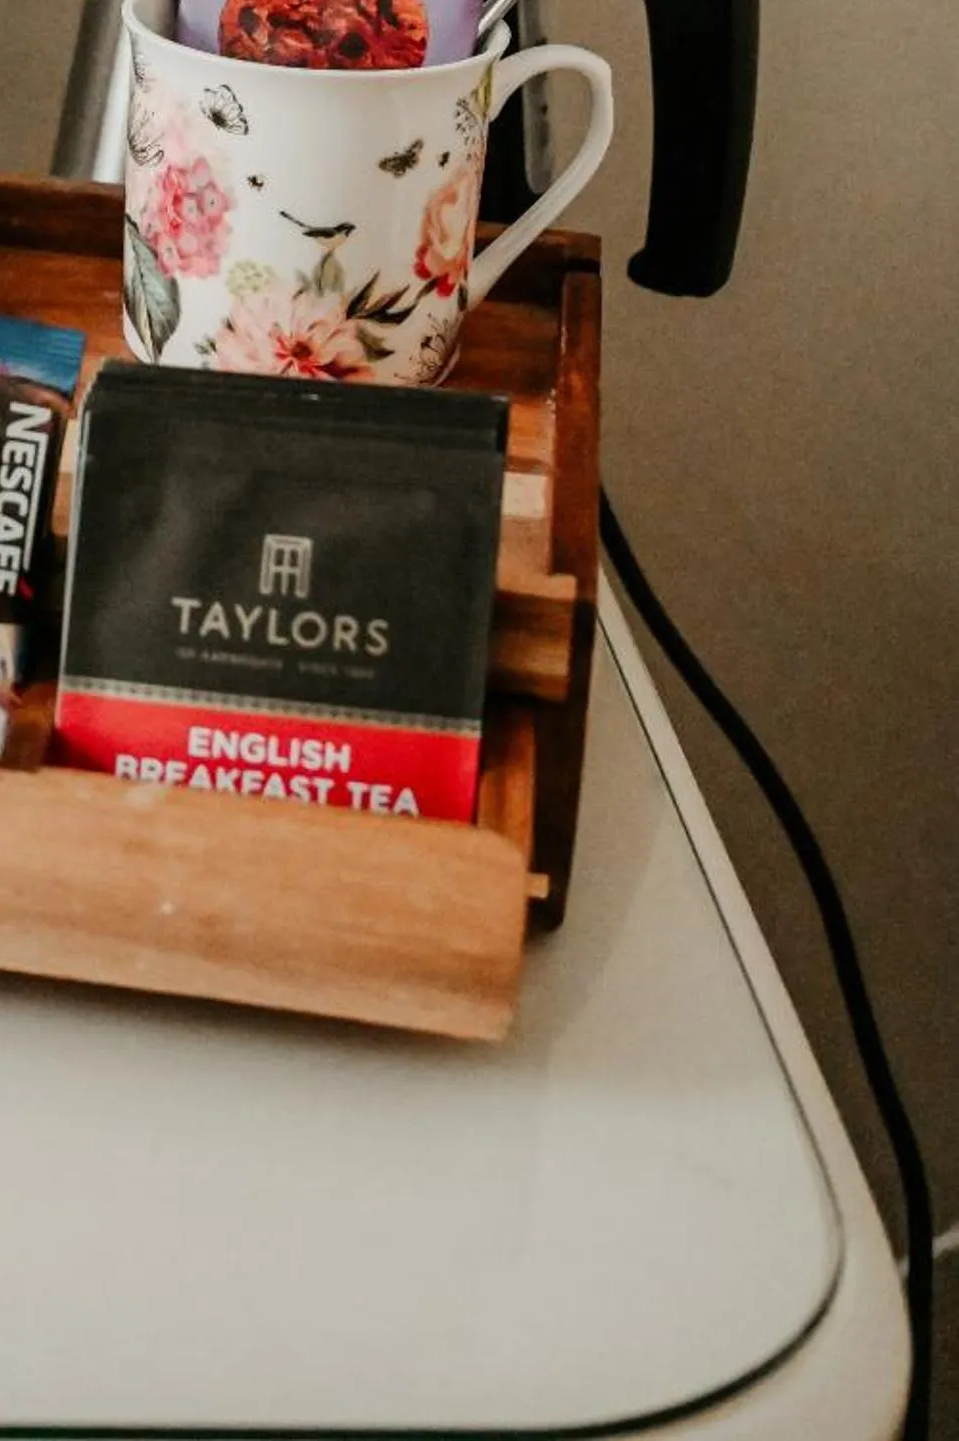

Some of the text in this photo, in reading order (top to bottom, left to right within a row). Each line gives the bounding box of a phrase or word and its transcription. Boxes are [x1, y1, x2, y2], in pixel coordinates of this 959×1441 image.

[171, 596, 390, 656] TAYLORS
[188, 726, 352, 773] ENGLISH
[114, 754, 420, 819] BREAKFAST TEA
